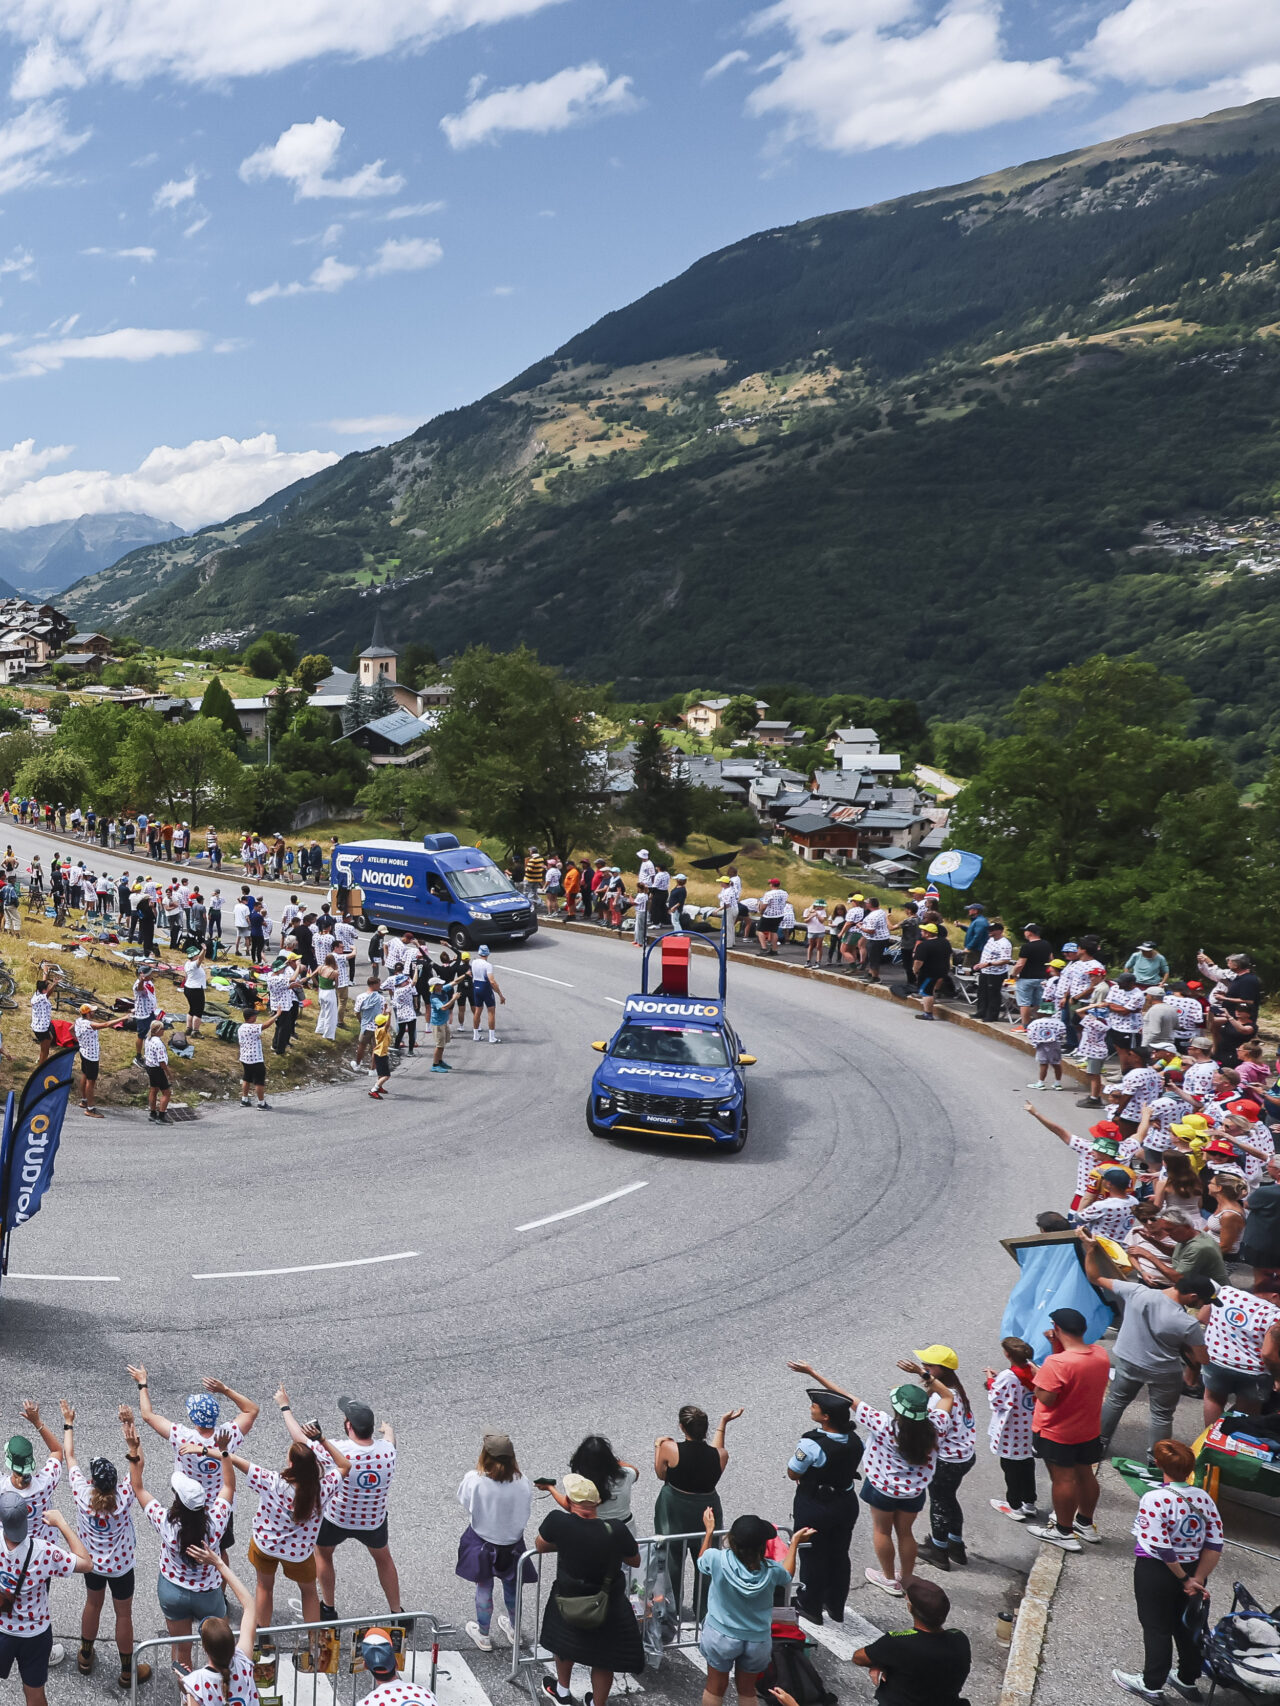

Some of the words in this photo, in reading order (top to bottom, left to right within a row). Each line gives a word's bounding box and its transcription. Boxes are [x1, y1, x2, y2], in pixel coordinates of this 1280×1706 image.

[367, 856, 387, 865] ATELIER
[361, 869, 414, 889] Norauto
[625, 999, 719, 1017] Norauto
[617, 1067, 716, 1083] Norauto
[646, 1115, 678, 1124] Norauto
